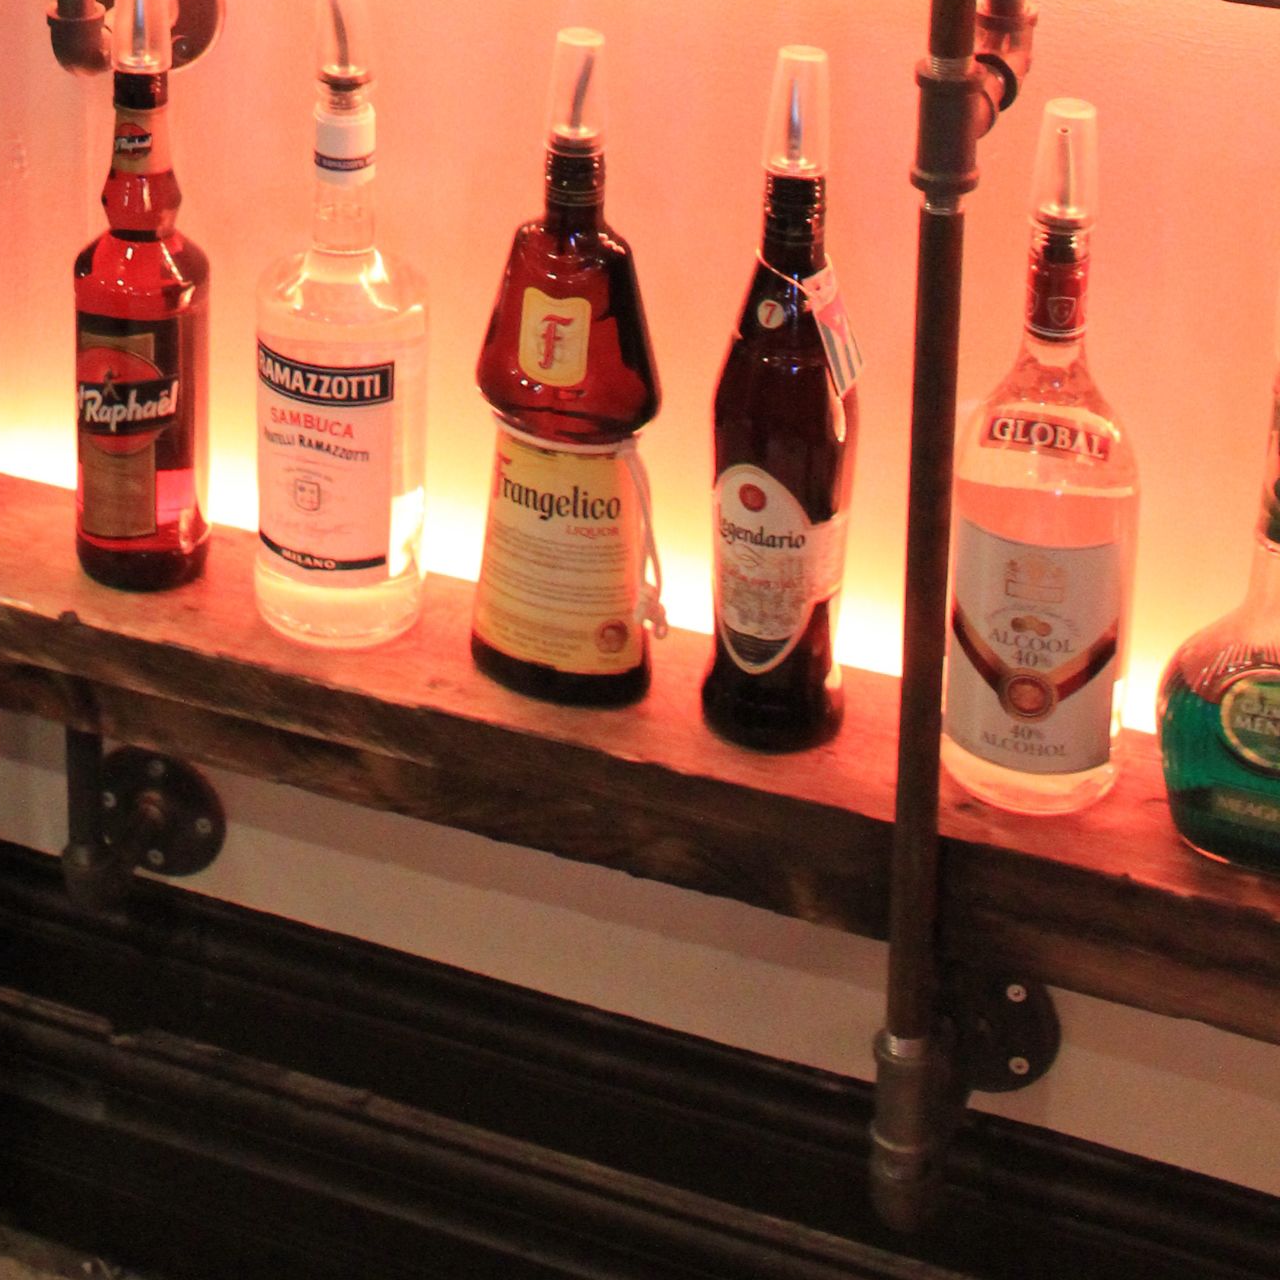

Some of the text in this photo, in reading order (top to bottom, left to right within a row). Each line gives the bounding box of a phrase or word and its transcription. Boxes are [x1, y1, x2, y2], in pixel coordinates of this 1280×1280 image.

[762, 302, 778, 325] 7
[258, 348, 381, 400] RAMAZZOTTI
[270, 407, 355, 439] SAMBUCA
[991, 417, 1107, 461] GLOBAL
[281, 548, 337, 570] MILANO
[989, 627, 1076, 653] ALCOOL
[982, 731, 1068, 757] ALCOHOL
